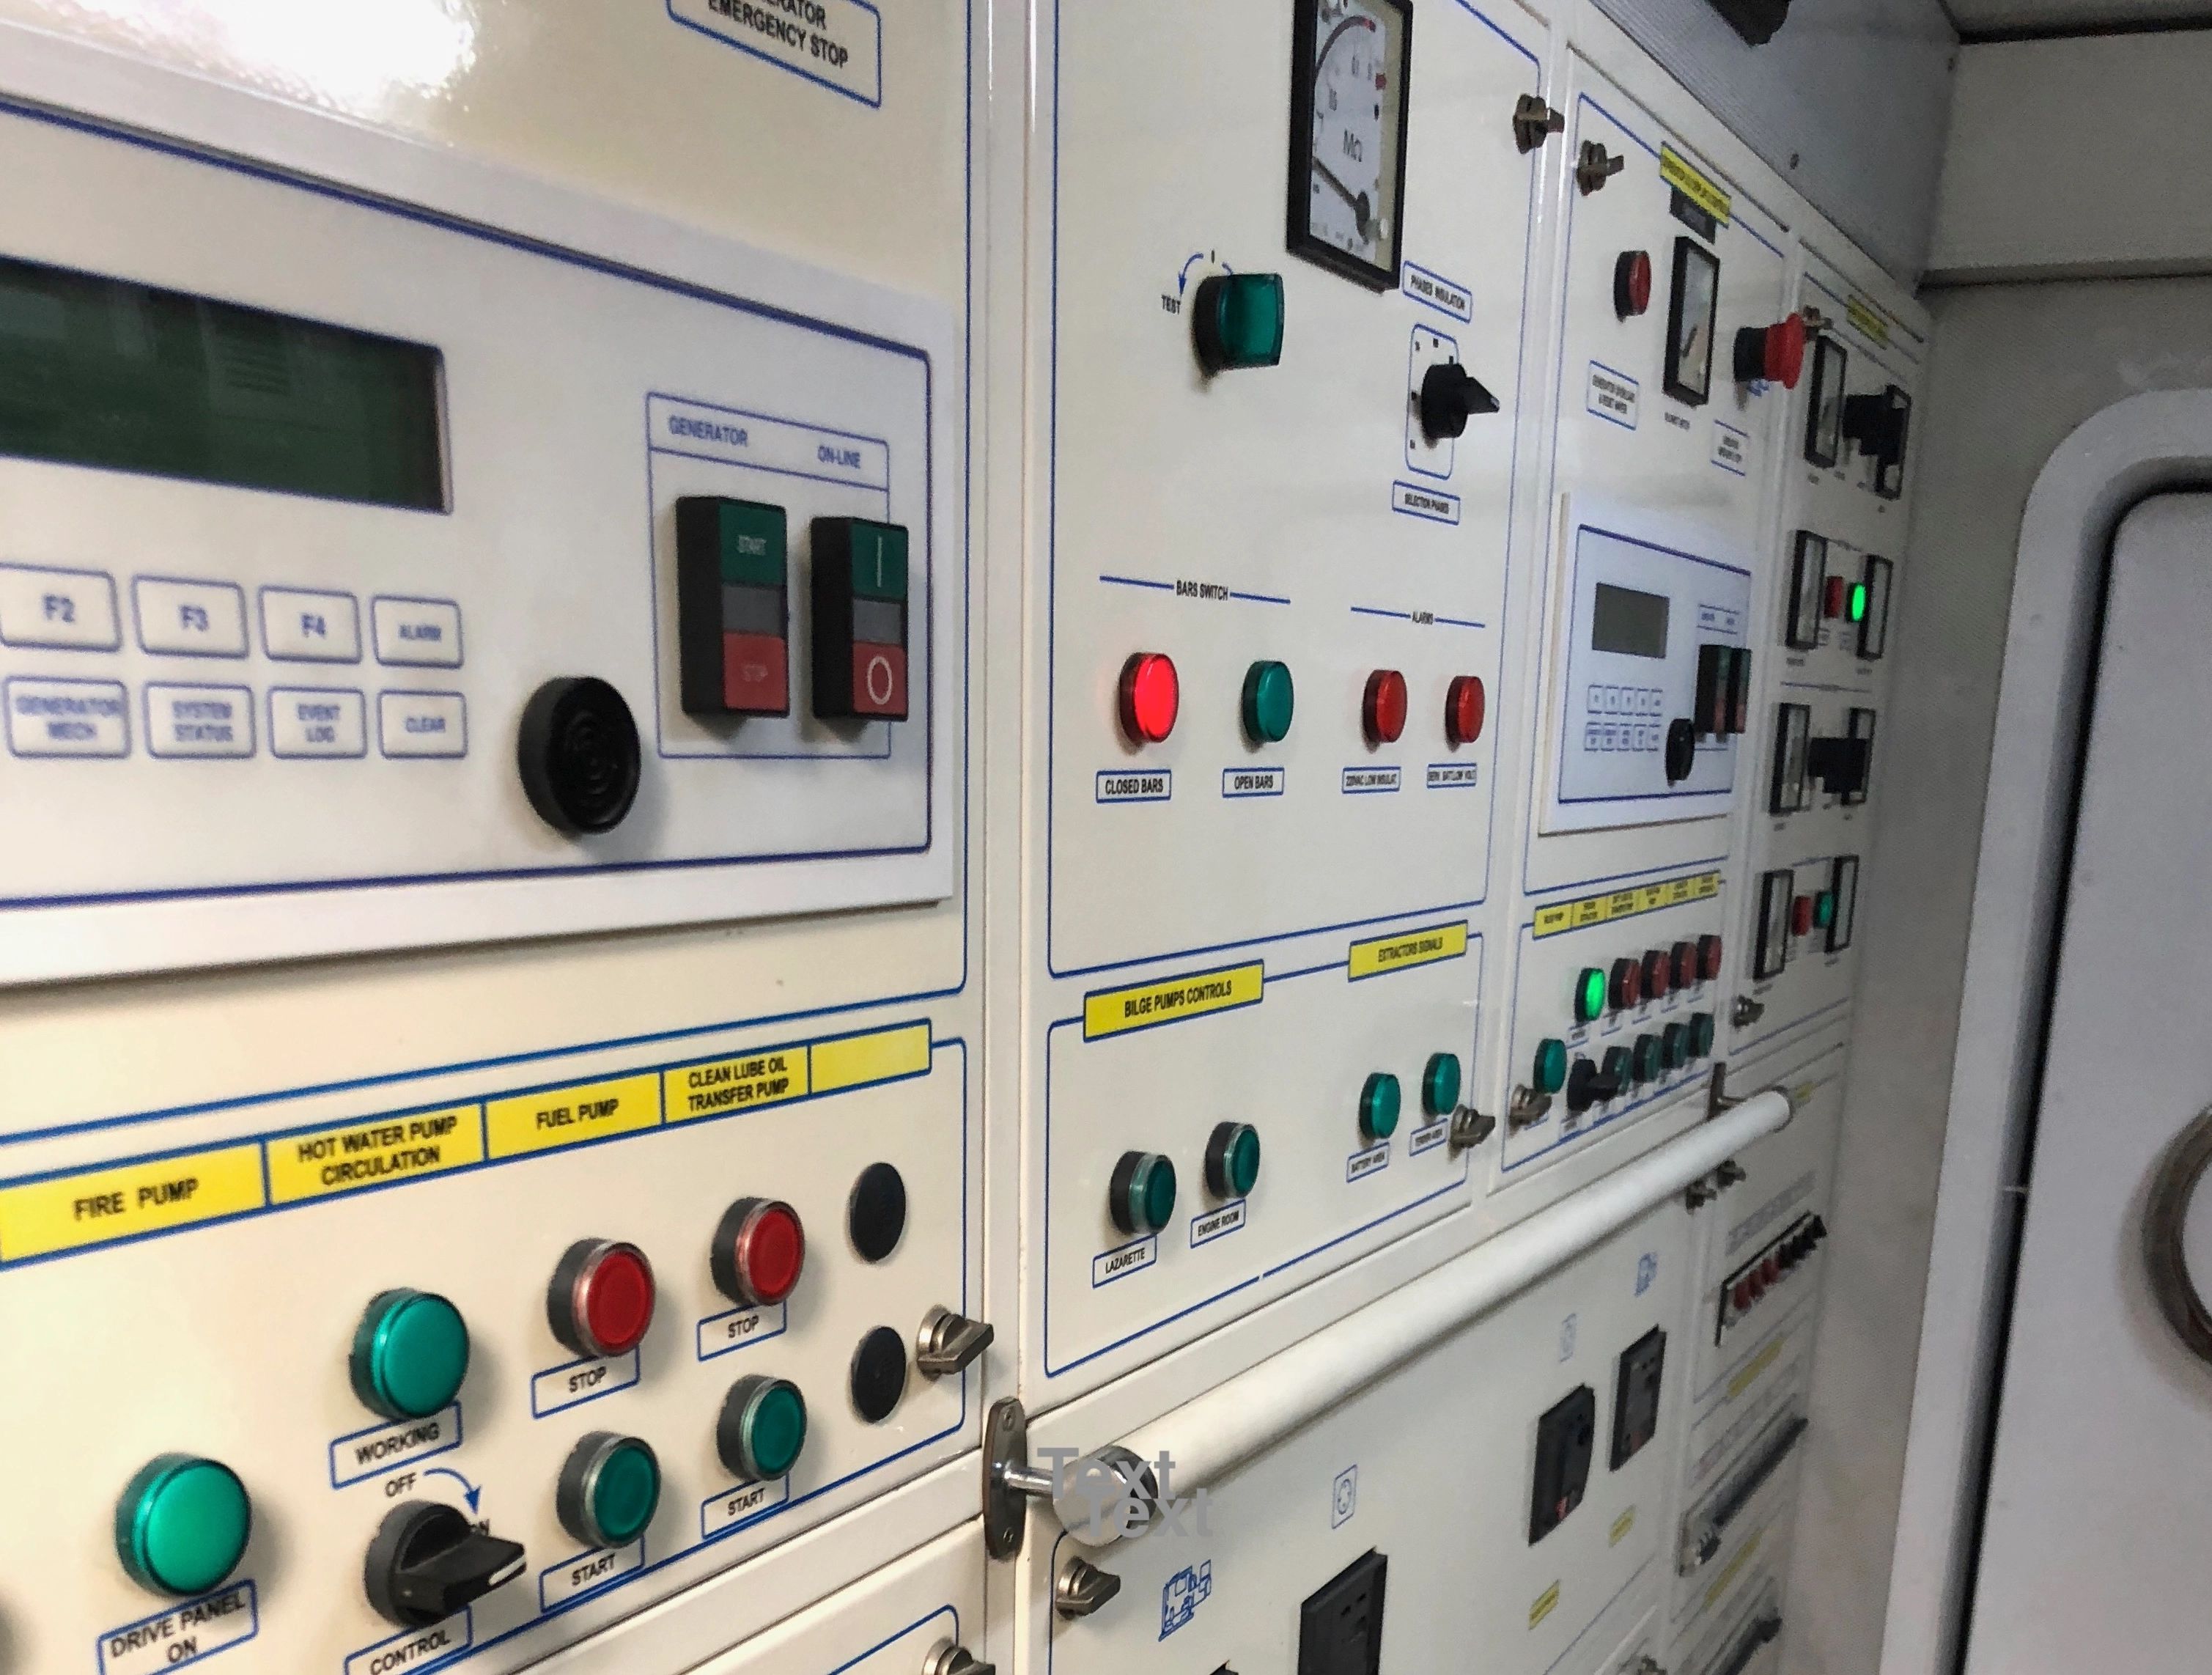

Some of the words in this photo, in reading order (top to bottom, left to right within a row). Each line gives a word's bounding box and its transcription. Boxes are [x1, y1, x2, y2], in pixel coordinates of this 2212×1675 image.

[709, 0, 806, 51] EMERGENCY
[811, 33, 848, 68] STOP
[1161, 295, 1181, 315] TEST
[668, 415, 748, 447] GENERATOR
[817, 445, 861, 469] ON-LINE
[1176, 580, 1198, 597] BARS
[1200, 583, 1228, 601] SWITCH
[43, 593, 73, 622] F2
[180, 605, 208, 631] F3
[301, 613, 325, 637] F4
[1105, 778, 1139, 795] CLOSED
[1140, 778, 1163, 793] BARS
[1234, 776, 1253, 789] OPEN
[1255, 774, 1274, 789] BARS
[1124, 993, 1152, 1018] BILGE
[1154, 987, 1185, 1012] PUMPS
[1186, 979, 1233, 1006] CONTROLS
[687, 1067, 731, 1089] CLEAN
[733, 1061, 766, 1081] LUBE
[767, 1056, 788, 1075] OIL
[687, 1085, 753, 1113] TRANSFER
[756, 1078, 789, 1100] PUMP
[536, 1108, 574, 1130] FUEL
[578, 1098, 620, 1122] PUMP
[298, 1138, 336, 1163] HOT
[342, 1124, 404, 1155] WATER
[410, 1115, 458, 1145] PUMP
[320, 1146, 441, 1187] CIRCULATION
[73, 1191, 125, 1222] FIRE
[139, 1178, 200, 1210] PUMP
[1198, 1218, 1220, 1237] ENGINE
[1222, 1210, 1239, 1226] ROOM
[1105, 1248, 1146, 1274] LAZARETTE
[728, 1314, 760, 1339] STOP
[569, 1366, 607, 1393] STOP
[355, 1421, 440, 1465] WORKING
[385, 1472, 416, 1497] OFF
[727, 1487, 766, 1516] START
[571, 1553, 615, 1587] START
[110, 1617, 175, 1658] DRIVE
[180, 1591, 246, 1631] PANEL
[167, 1636, 198, 1663] ON
[370, 1630, 451, 1675] CONTROL
